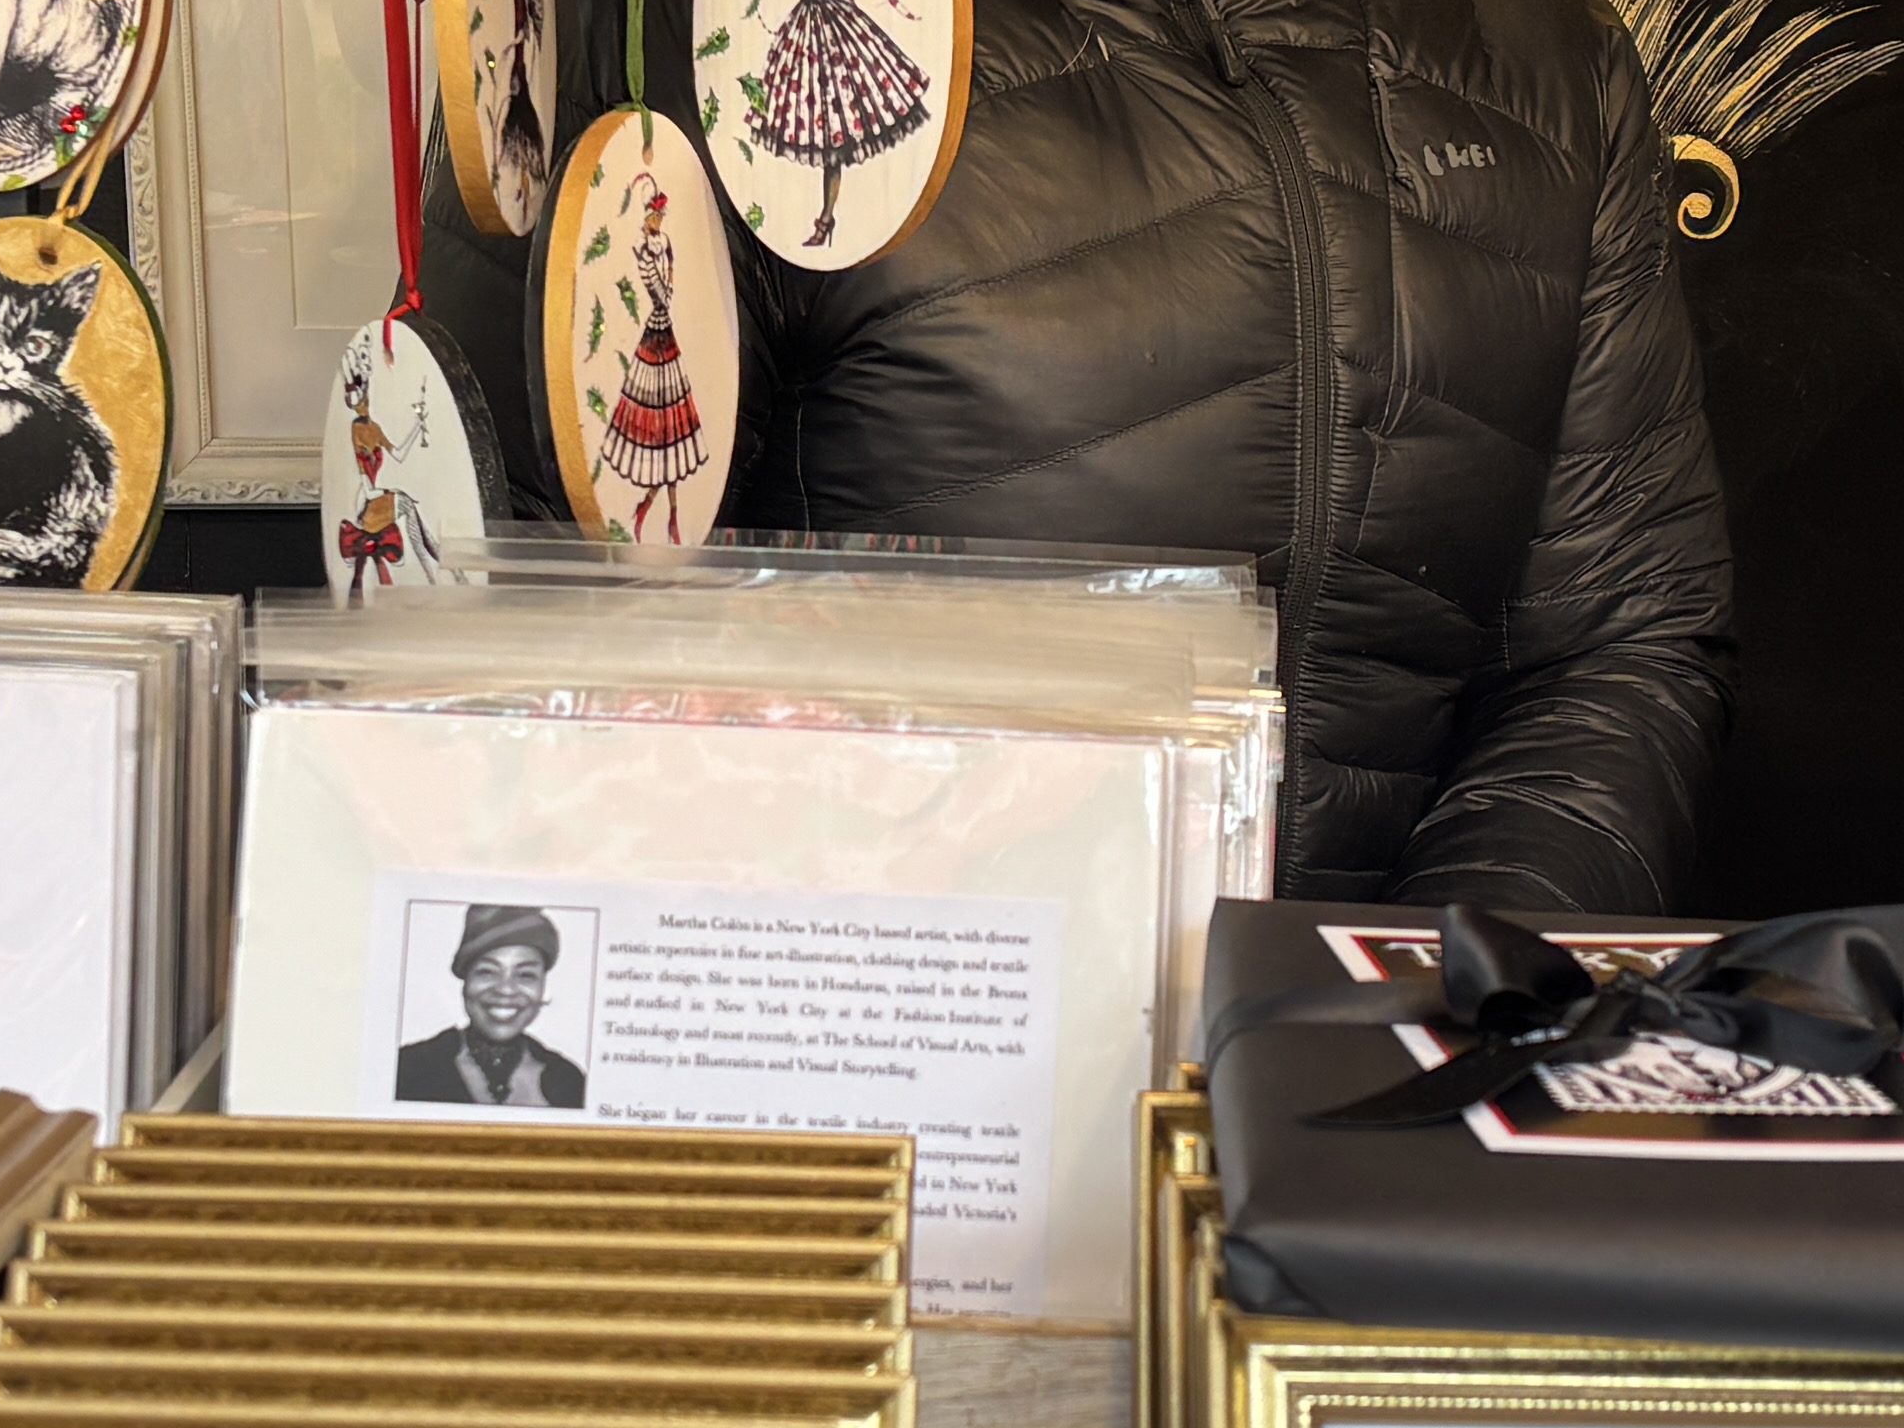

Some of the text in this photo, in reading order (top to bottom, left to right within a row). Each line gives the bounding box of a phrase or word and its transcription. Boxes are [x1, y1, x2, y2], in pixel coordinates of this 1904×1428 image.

[658, 914, 708, 931] Martha
[776, 919, 806, 934] New
[809, 920, 840, 937] York
[843, 922, 870, 942] City
[874, 924, 912, 941] based
[954, 929, 983, 944] with
[985, 930, 1030, 946] diverse
[608, 941, 652, 956] artistic
[655, 943, 717, 959] repertoire
[737, 945, 762, 960] fine
[863, 951, 915, 971] clothing
[918, 953, 959, 973] design
[962, 957, 987, 972] and
[990, 957, 1028, 974] textile
[606, 967, 654, 982] surface
[707, 970, 733, 986] She
[737, 975, 762, 987] was
[767, 973, 800, 989] born
[821, 977, 891, 996] Honduras,
[895, 981, 936, 997] raised
[960, 982, 981, 998] the
[988, 985, 1028, 1001] Bronx
[604, 994, 631, 1008] and
[634, 995, 681, 1010] studied
[714, 998, 745, 1013] New
[757, 999, 789, 1016] York
[799, 1002, 827, 1019] City
[862, 1005, 883, 1021] the
[894, 1006, 947, 1023] Fashion
[948, 1010, 1003, 1026] Institute
[604, 1020, 681, 1042] Technology
[684, 1025, 710, 1040] and
[712, 1028, 744, 1042] most
[823, 1031, 850, 1047] The
[852, 1033, 898, 1050] School
[916, 1035, 958, 1052] Visual
[960, 1039, 994, 1056] Arts,
[996, 1040, 1026, 1056] with
[612, 1048, 674, 1068] residency
[694, 1052, 765, 1069] Illustration
[767, 1056, 794, 1071] and
[796, 1057, 839, 1074] Visual
[598, 1102, 623, 1118] She
[627, 1104, 666, 1122] began
[674, 1107, 698, 1122] her
[704, 1111, 748, 1124] career
[776, 1112, 800, 1126] the
[919, 1119, 972, 1138] creating
[949, 1176, 980, 1192] New
[985, 1176, 1018, 1194] York
[952, 1205, 1018, 1223] Victoria's
[961, 1276, 987, 1293] and
[989, 1277, 1013, 1294] her
